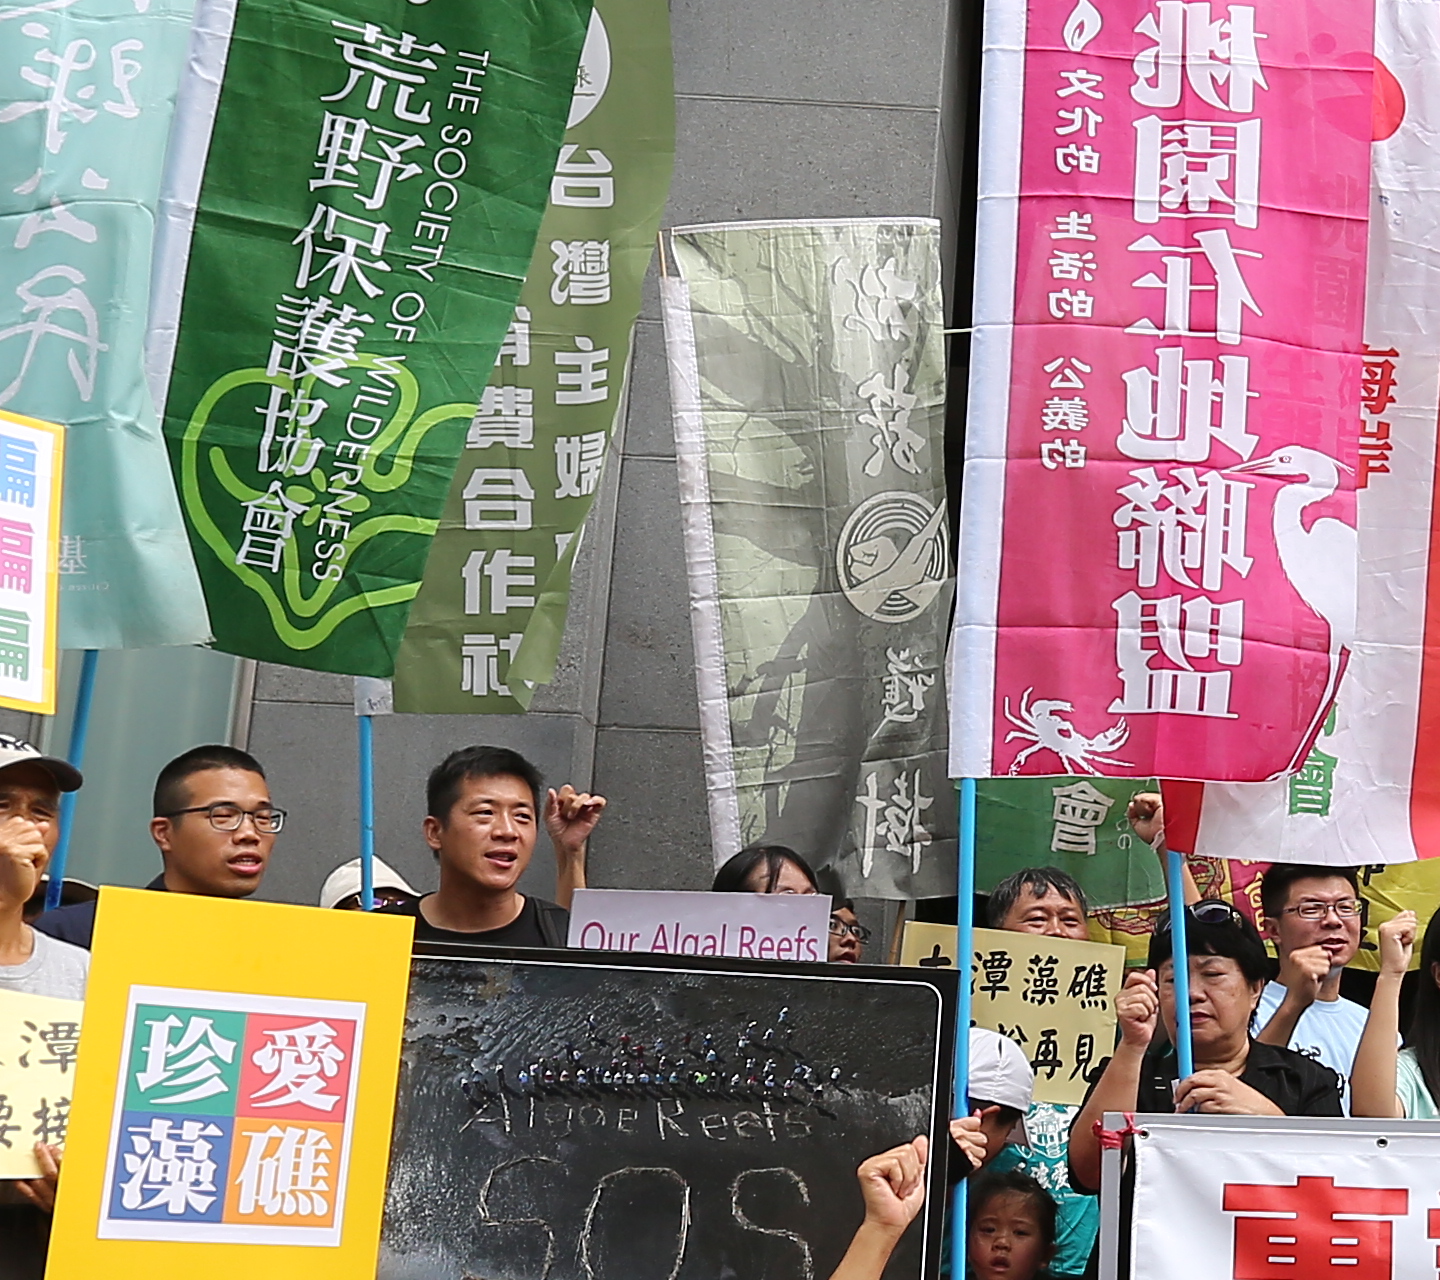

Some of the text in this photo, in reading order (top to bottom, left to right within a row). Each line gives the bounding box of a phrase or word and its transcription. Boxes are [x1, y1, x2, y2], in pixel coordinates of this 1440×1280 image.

[235, 19, 447, 576] 荒野保護協會
[313, 48, 491, 583] THE SOCIETY OF WILDERNESS
[548, 143, 616, 562] 台灣主婦
[580, 921, 819, 962] Our Algal Reefs
